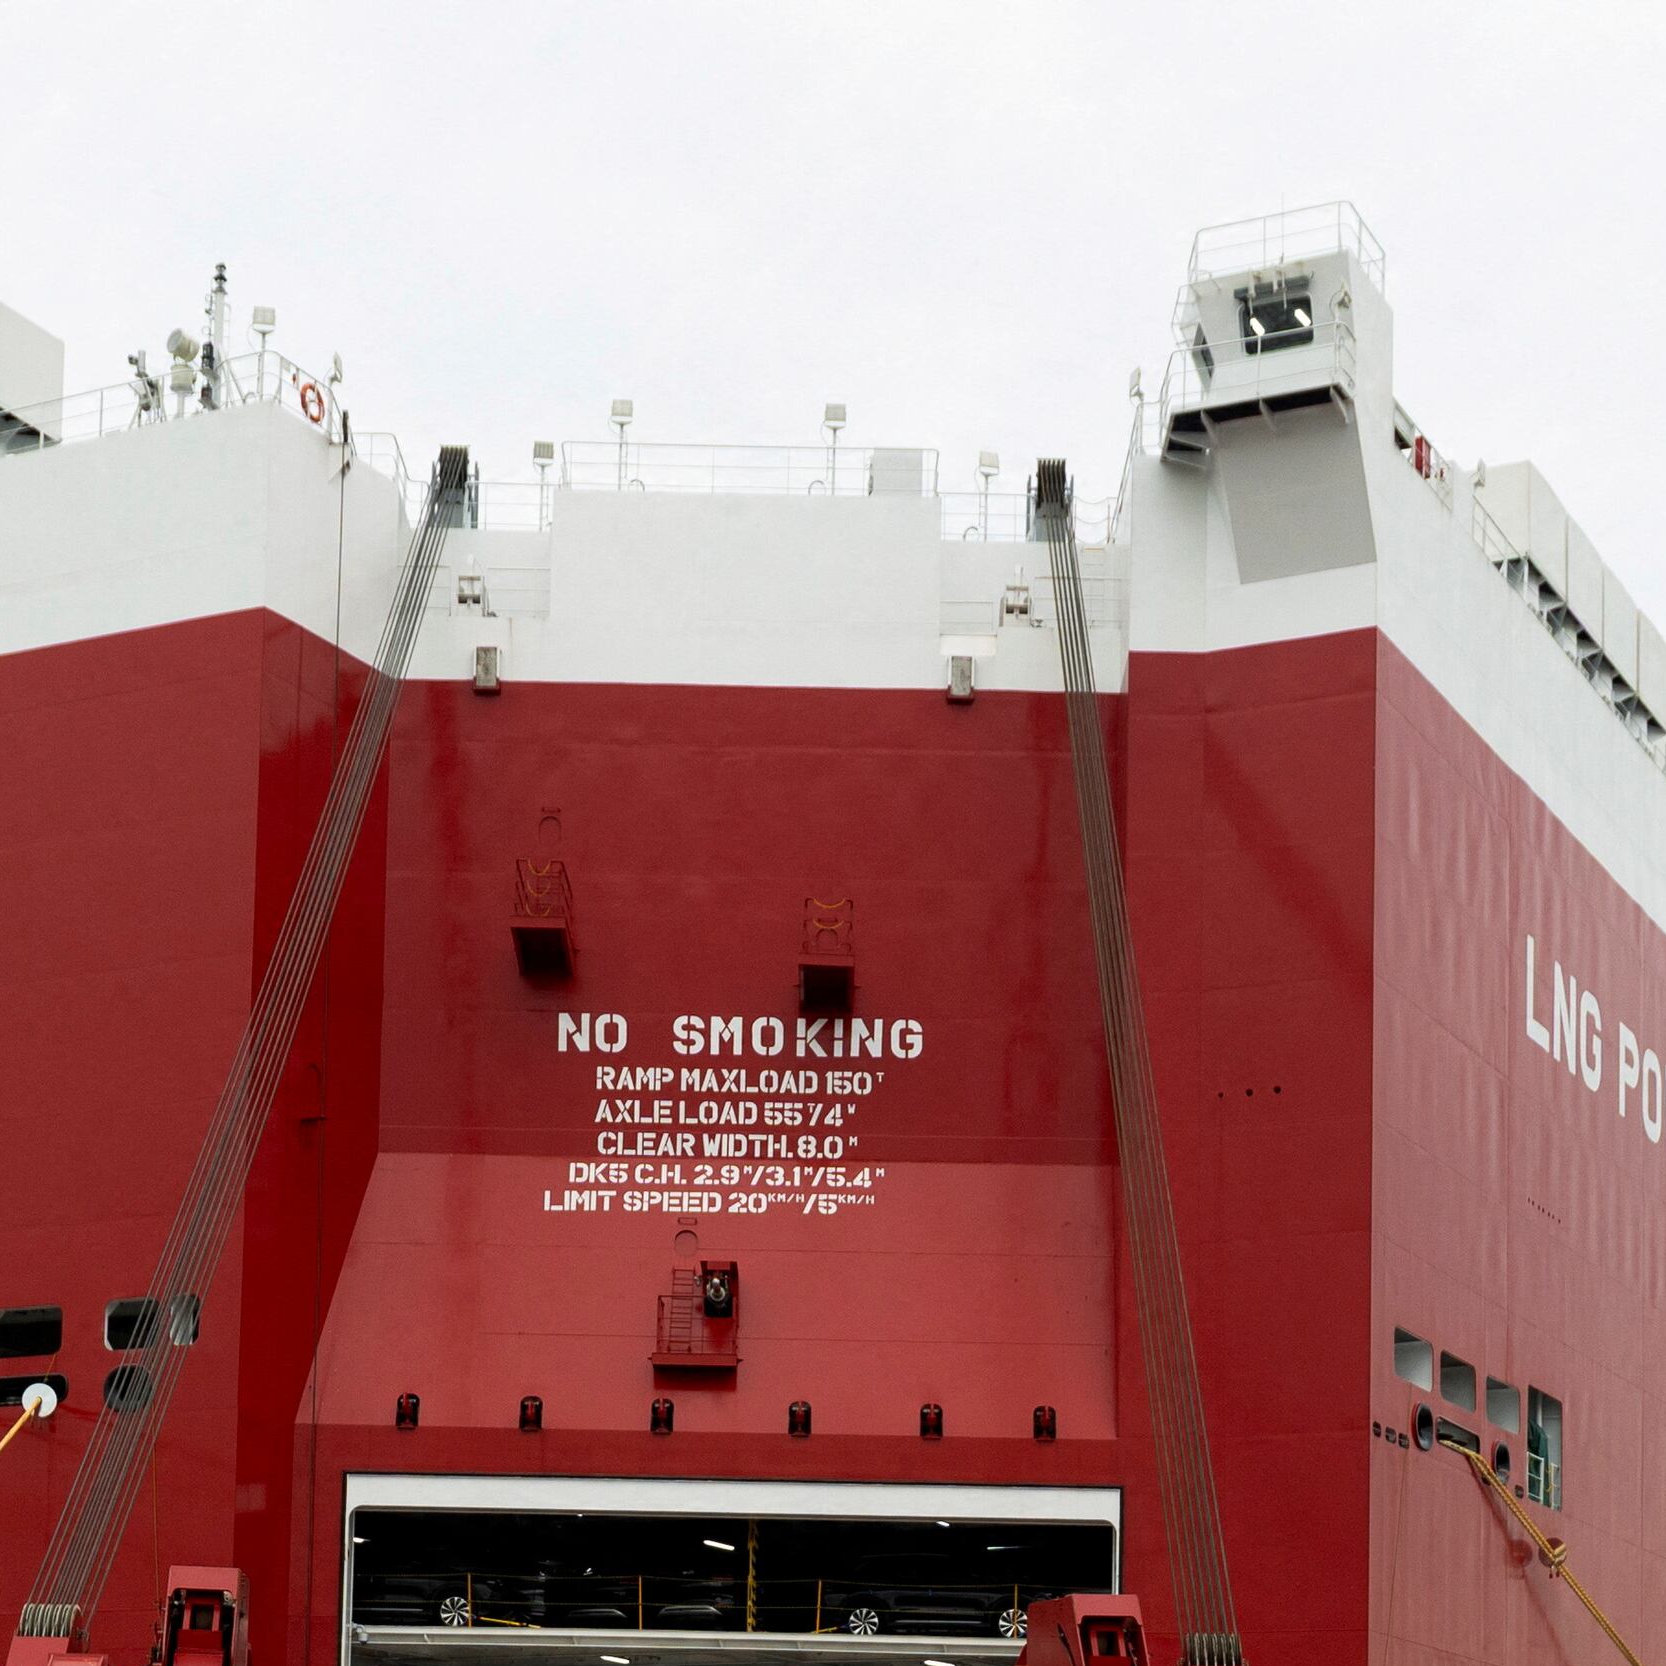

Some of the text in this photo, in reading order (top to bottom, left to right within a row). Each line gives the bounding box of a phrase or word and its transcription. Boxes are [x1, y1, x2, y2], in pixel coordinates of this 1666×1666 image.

[1526, 934, 1603, 1092] LNG
[557, 1012, 923, 1059] NO SMOKING
[596, 1066, 674, 1091] RAMP
[680, 1068, 818, 1094] MAXLOAD
[594, 1099, 673, 1124] AXLE
[678, 1100, 758, 1125] LOAD
[597, 1131, 695, 1157] CLEAR
[634, 1163, 687, 1185] C.H.
[543, 1189, 617, 1212] LIMIT
[622, 1190, 723, 1213] SPEED
